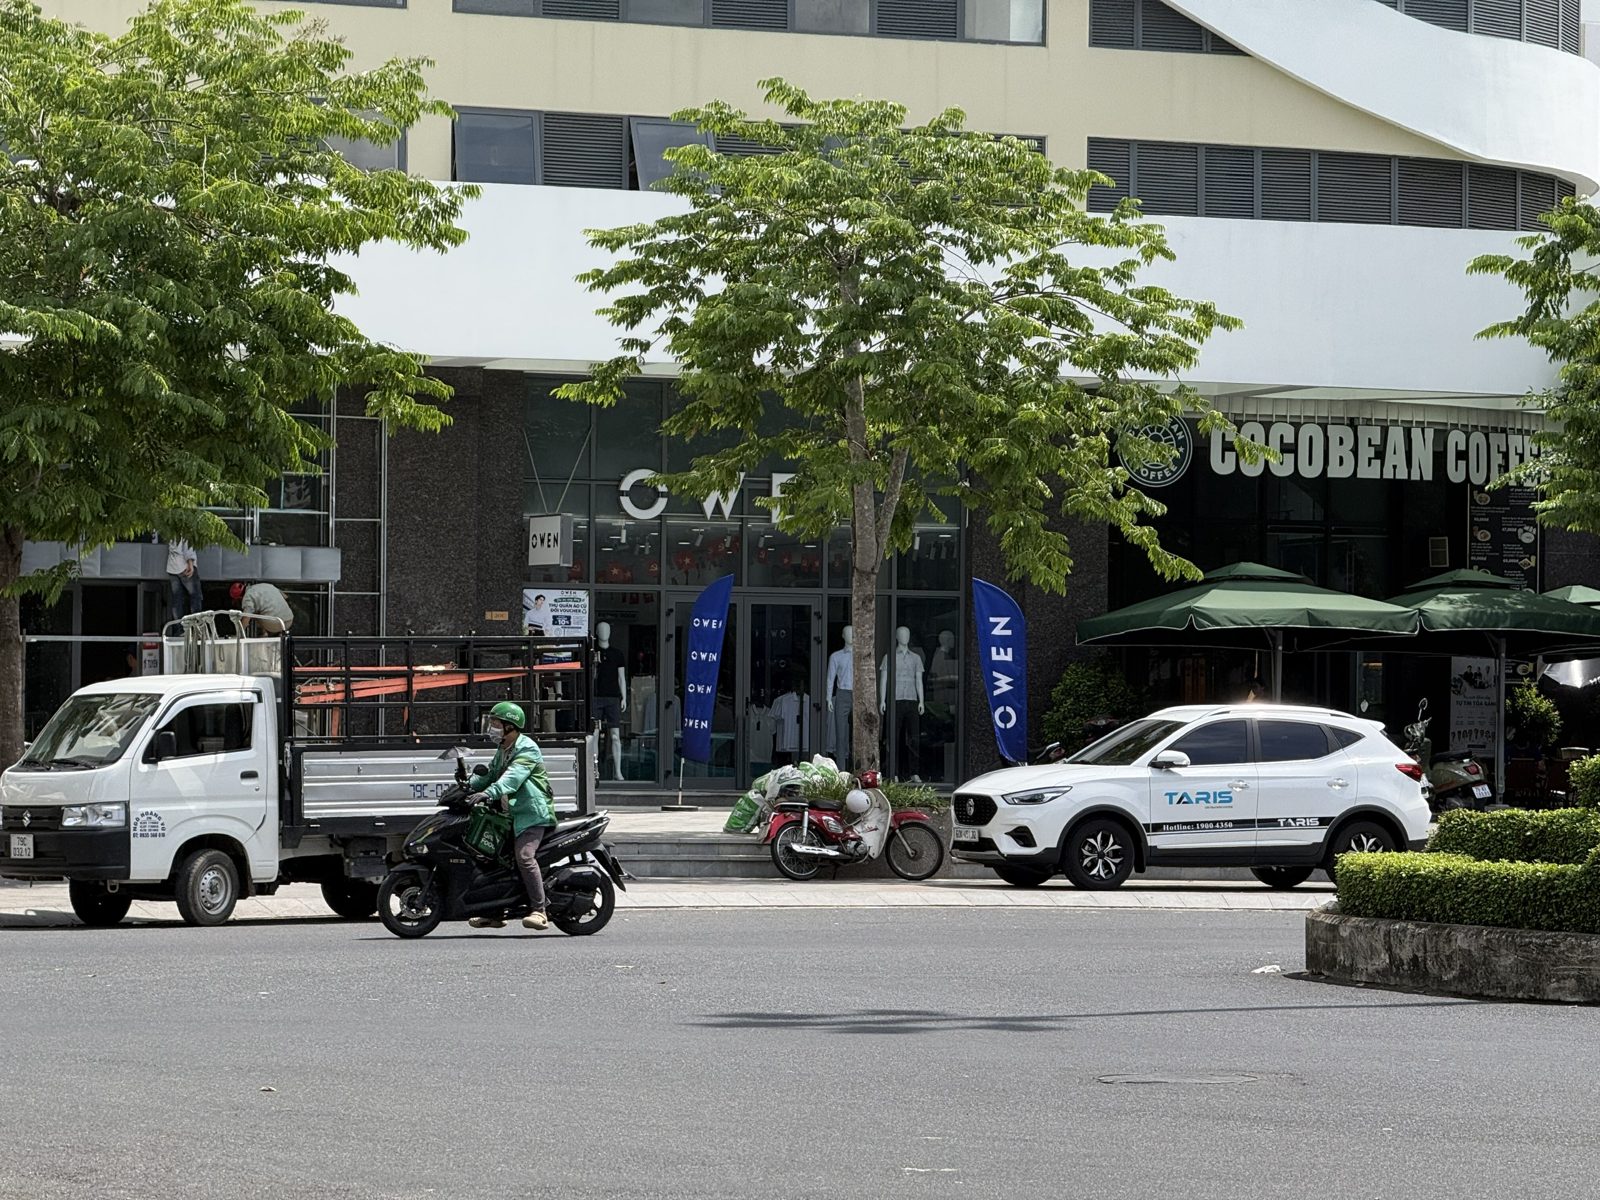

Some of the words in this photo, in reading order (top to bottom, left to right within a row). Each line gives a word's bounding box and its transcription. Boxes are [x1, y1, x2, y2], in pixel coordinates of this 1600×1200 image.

[1210, 421, 1434, 481] COCOBEAN
[1139, 463, 1179, 480] OFFEE
[531, 532, 559, 549] OWEN
[989, 616, 1017, 729] OWEN
[506, 712, 520, 721] Grab
[1164, 790, 1233, 805] TARIS
[1162, 823, 1195, 831] Hotline:
[1196, 822, 1214, 830] 1900
[1215, 821, 1233, 829] 4350
[1277, 817, 1320, 827] TARIS
